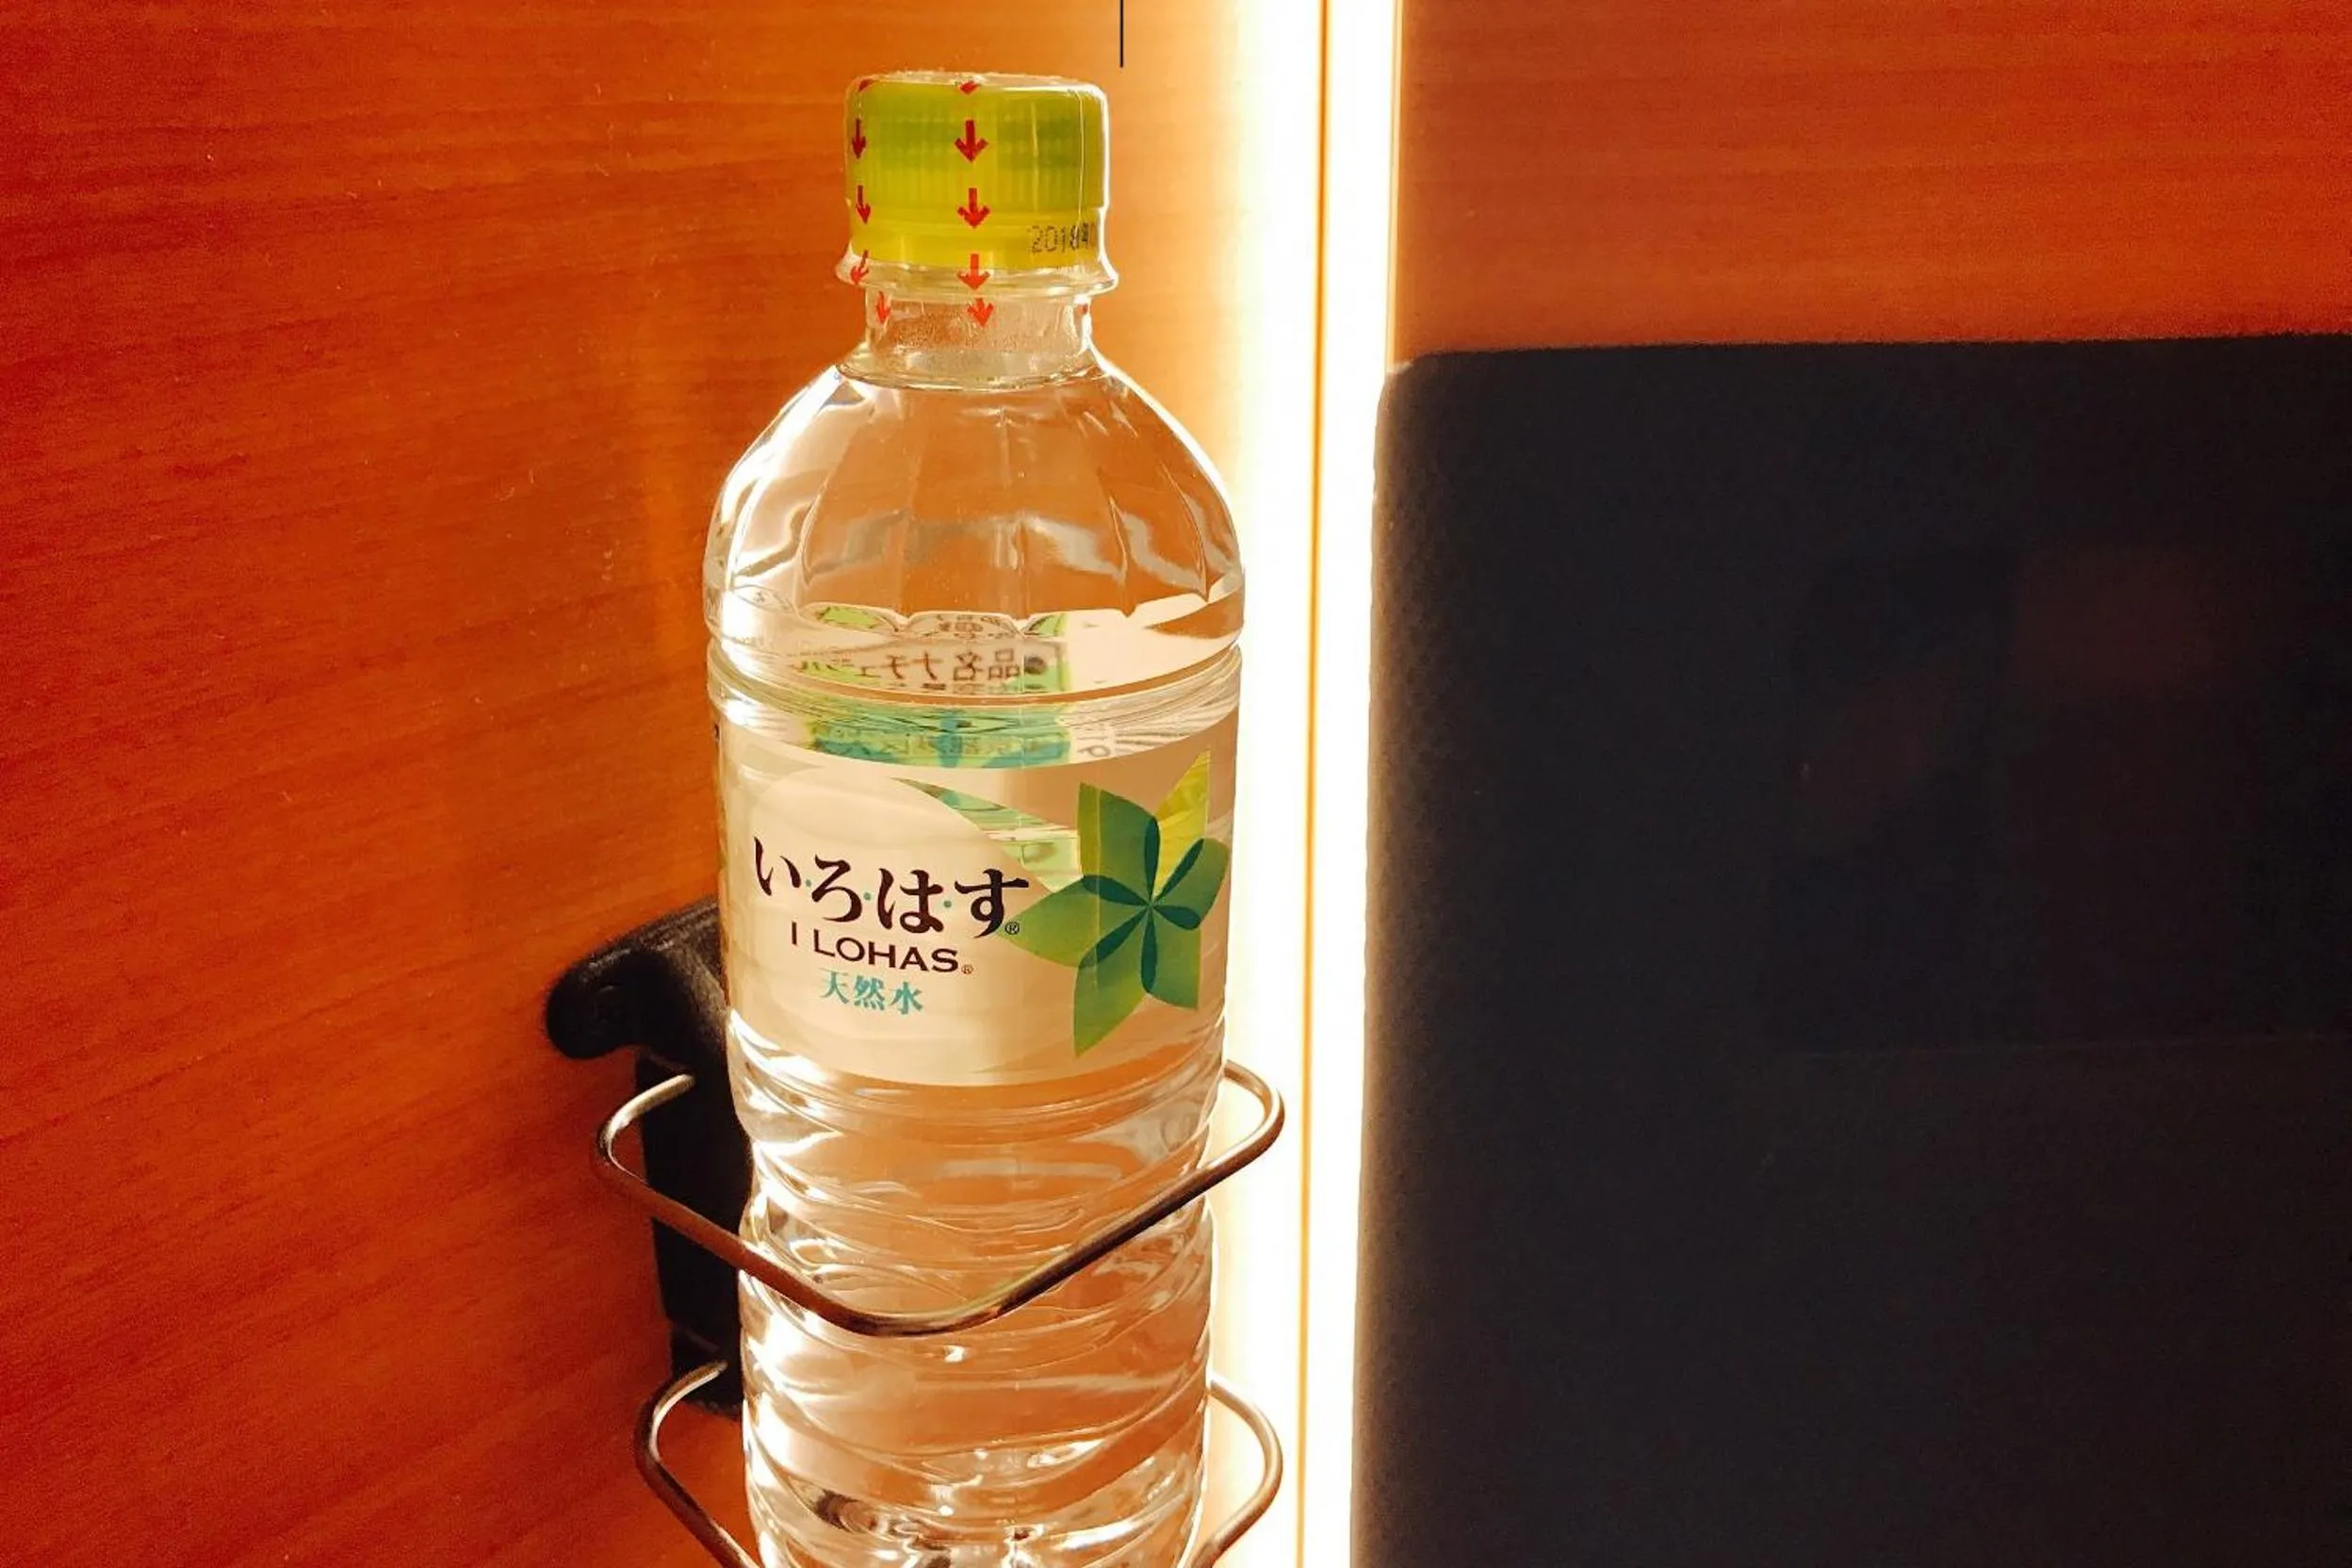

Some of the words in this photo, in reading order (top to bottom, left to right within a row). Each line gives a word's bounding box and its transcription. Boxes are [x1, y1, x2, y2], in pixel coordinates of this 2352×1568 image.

[791, 921, 798, 946] I
[820, 968, 924, 1015] 天然水
